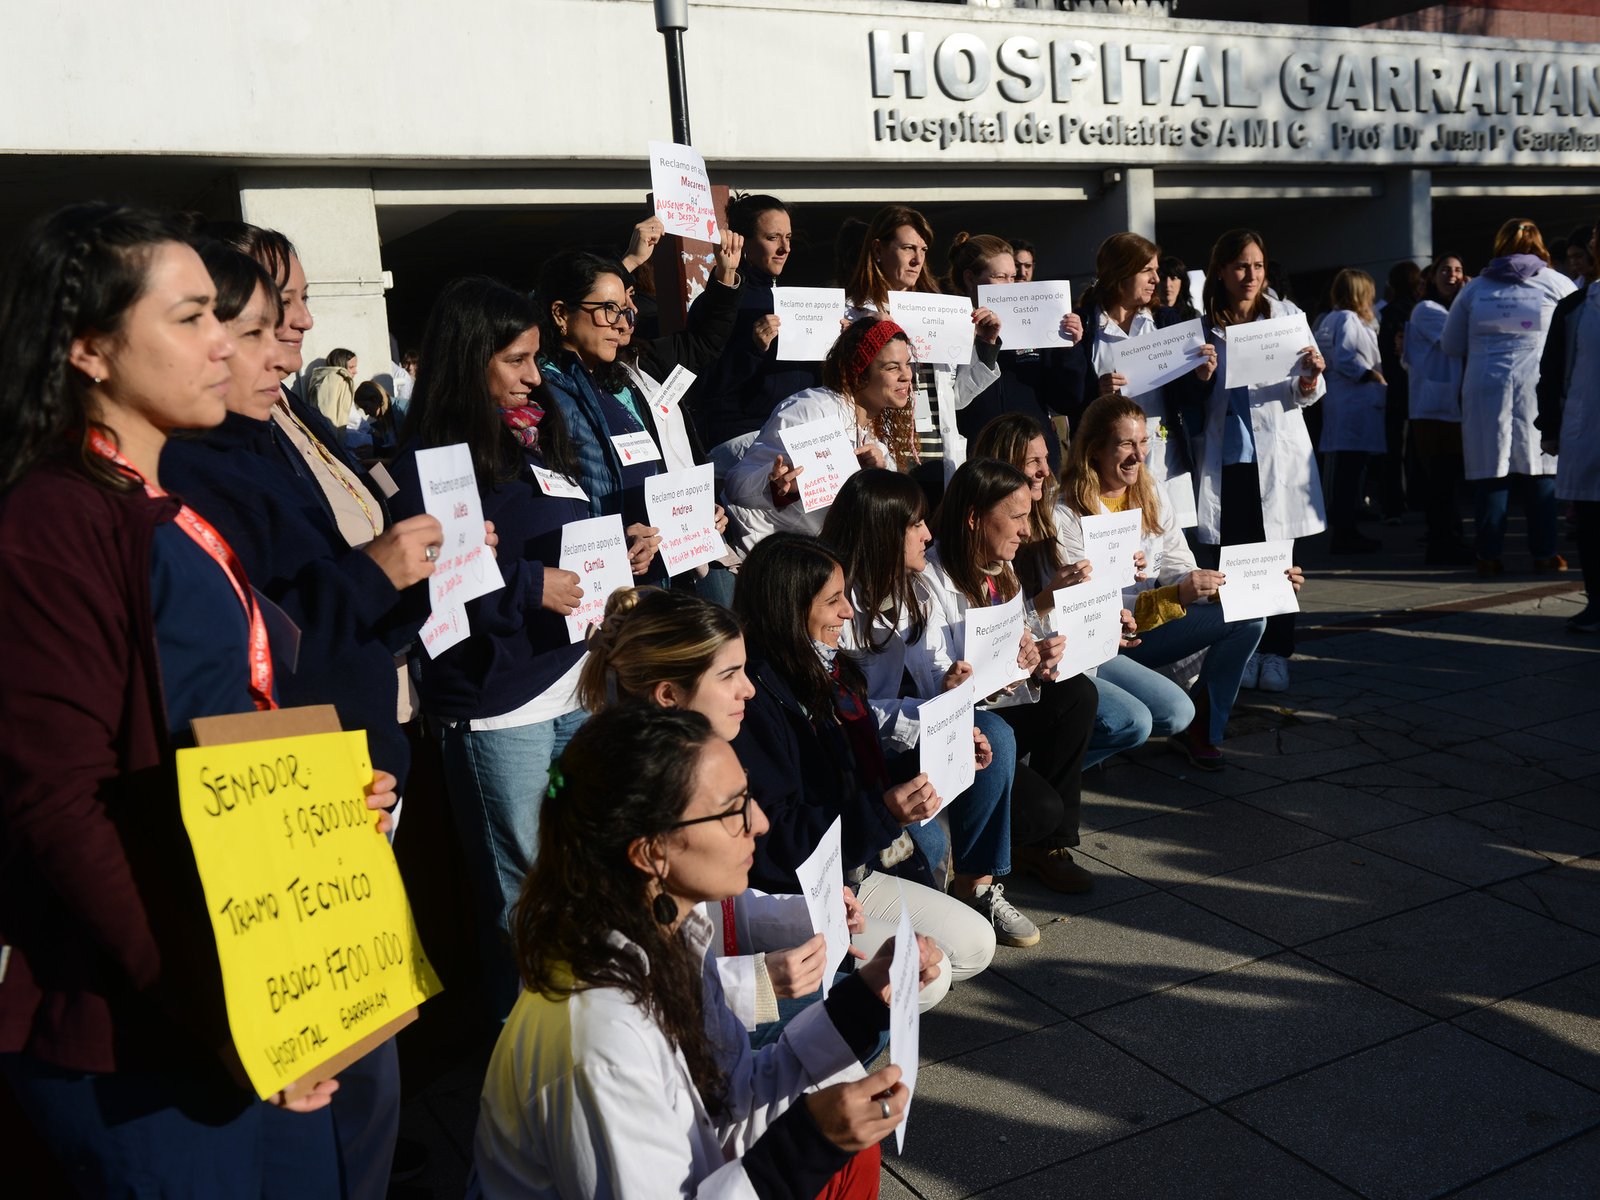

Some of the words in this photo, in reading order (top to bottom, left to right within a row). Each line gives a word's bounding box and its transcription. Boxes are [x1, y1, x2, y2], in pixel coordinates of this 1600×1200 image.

[868, 30, 1261, 108] HOSPITAL
[1280, 51, 1600, 117] GARRAHAN
[874, 108, 1008, 151] Hospital
[1015, 112, 1055, 145] de
[1332, 121, 1386, 150] Prof
[1394, 122, 1425, 151] Dr
[1431, 123, 1486, 151] Juan
[1489, 125, 1505, 151] P
[660, 157, 690, 171] Reclamo
[681, 175, 706, 191] Macarena
[780, 300, 804, 308] Reclamo
[814, 301, 831, 310] apoyo
[986, 294, 1018, 304] Reclamo
[1030, 293, 1053, 302] apoyo
[1055, 292, 1064, 300] de
[898, 303, 927, 312] Reclamo
[937, 307, 958, 315] apoyo
[1013, 305, 1039, 314] Gastón
[795, 313, 823, 321] Constanza
[922, 317, 945, 325] Camila
[1022, 318, 1031, 326] R4
[1234, 333, 1263, 344] Reclamo
[1274, 329, 1294, 339] apoyo
[1120, 343, 1151, 358] Reclamo
[1152, 340, 1162, 348] en
[1163, 335, 1186, 348] apoyo
[1186, 331, 1196, 340] de
[1261, 342, 1280, 351] Laura
[1148, 350, 1173, 361] Camila
[1158, 363, 1168, 371] R4
[790, 440, 812, 451] Reclamo
[819, 432, 834, 444] apoyo
[652, 490, 675, 504] Reclamo
[676, 489, 684, 498] en
[686, 485, 703, 497] apoyo
[704, 481, 711, 490] de
[672, 504, 693, 517] Andrea
[681, 523, 689, 534] R4
[1089, 529, 1110, 540] Reclamo
[564, 543, 586, 556] Reclamo
[587, 542, 595, 551] en
[596, 538, 612, 551] apoyo
[613, 535, 621, 546] de
[584, 558, 605, 574] Camila
[1225, 557, 1251, 567] Reclamo
[1260, 556, 1278, 564] apoyo
[1278, 553, 1286, 561] de
[1243, 569, 1267, 579] Johanna
[594, 581, 602, 592] R4
[1063, 601, 1087, 614] Reclamo
[1088, 598, 1095, 606] en
[1096, 593, 1111, 605] apoyo
[1112, 589, 1118, 598] de
[976, 622, 1002, 636] Reclamo
[1088, 629, 1095, 638] R4
[927, 718, 948, 737] Reclamo
[949, 713, 955, 724] en
[955, 704, 967, 720] apoyo
[200, 754, 312, 817] SENADOR:
[220, 892, 280, 937] TRAMO
[266, 963, 321, 1014] BASICO
[264, 1023, 329, 1078] HOSPITAL
[339, 986, 390, 1030] GARRAHAN
